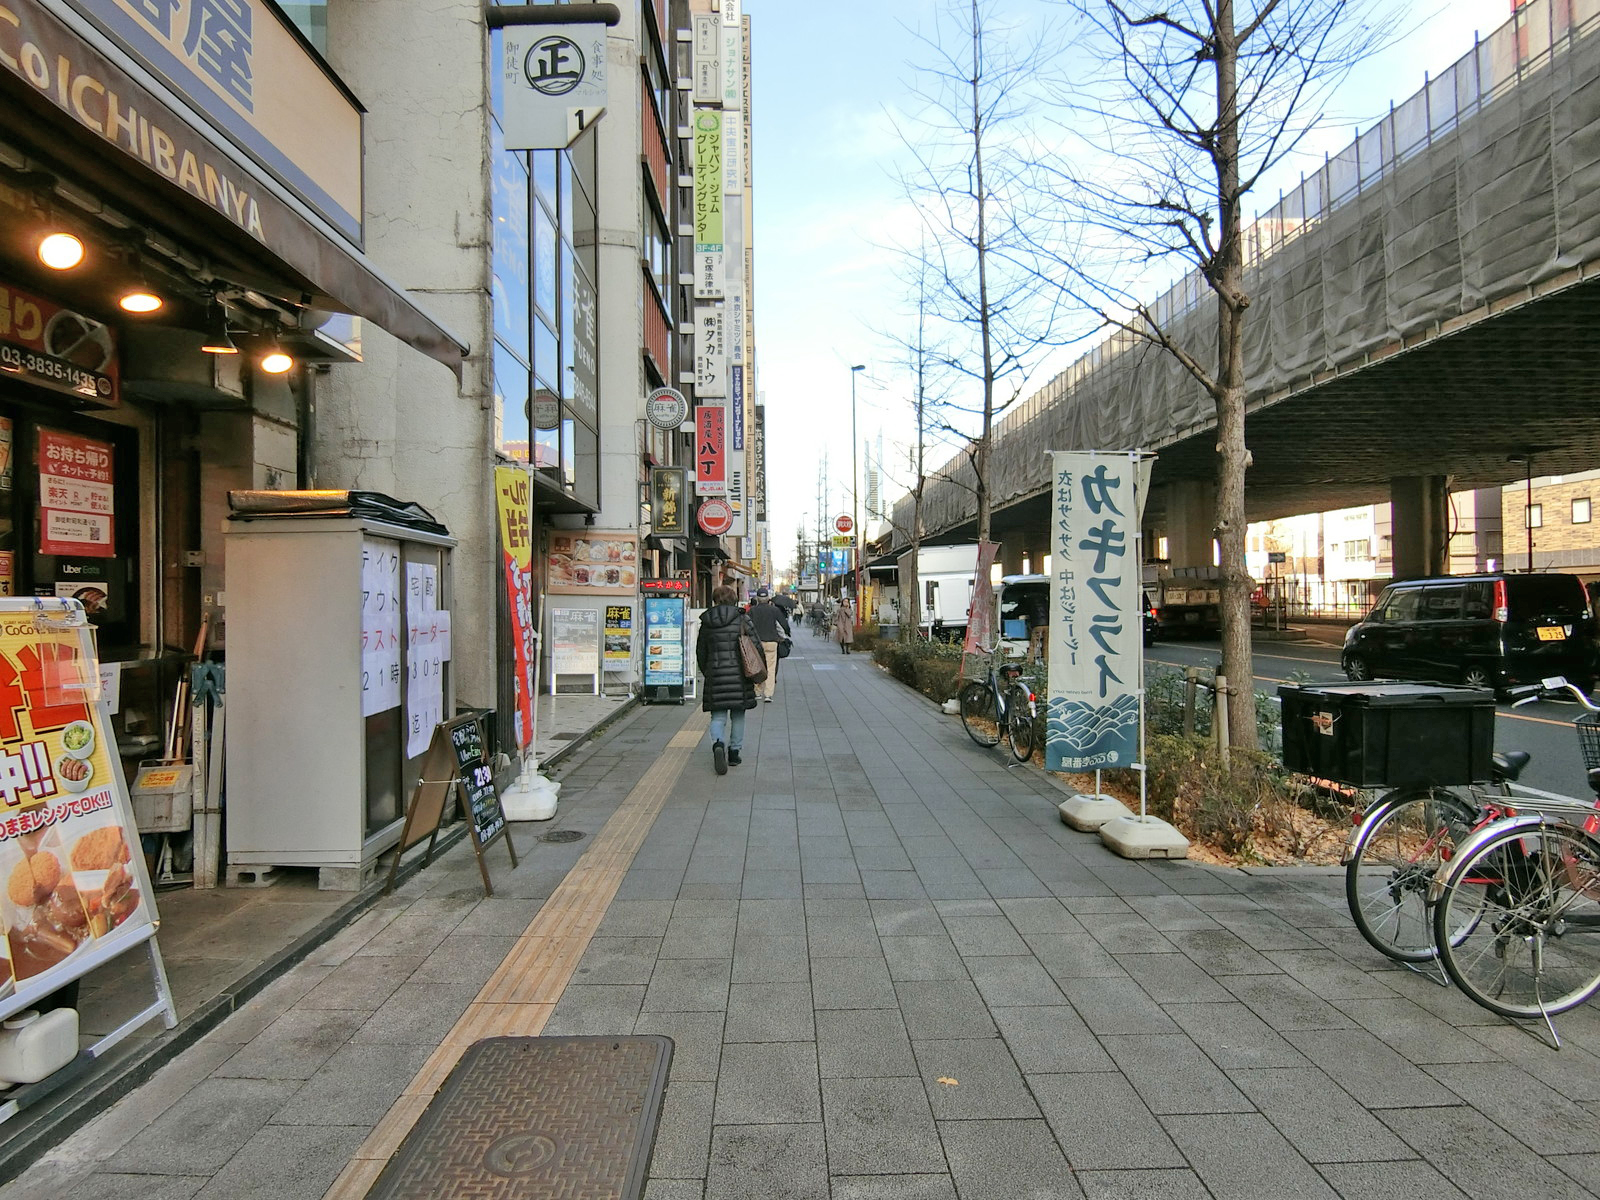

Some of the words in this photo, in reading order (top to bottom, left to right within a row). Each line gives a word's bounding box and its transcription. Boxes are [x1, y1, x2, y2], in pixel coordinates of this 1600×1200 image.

[505, 41, 520, 84] 御徒町
[574, 109, 584, 131] 1
[709, 134, 720, 214] ジャパン・ジェム
[696, 134, 707, 242] グレーディングセンター
[704, 256, 714, 289] 石塚法律
[46, 443, 109, 468] お持ち帰り
[700, 441, 717, 476] 八丁
[63, 564, 81, 574] Uber
[570, 611, 597, 623] 麻雀
[607, 606, 631, 619] 麻雀
[410, 625, 448, 642] オーダー
